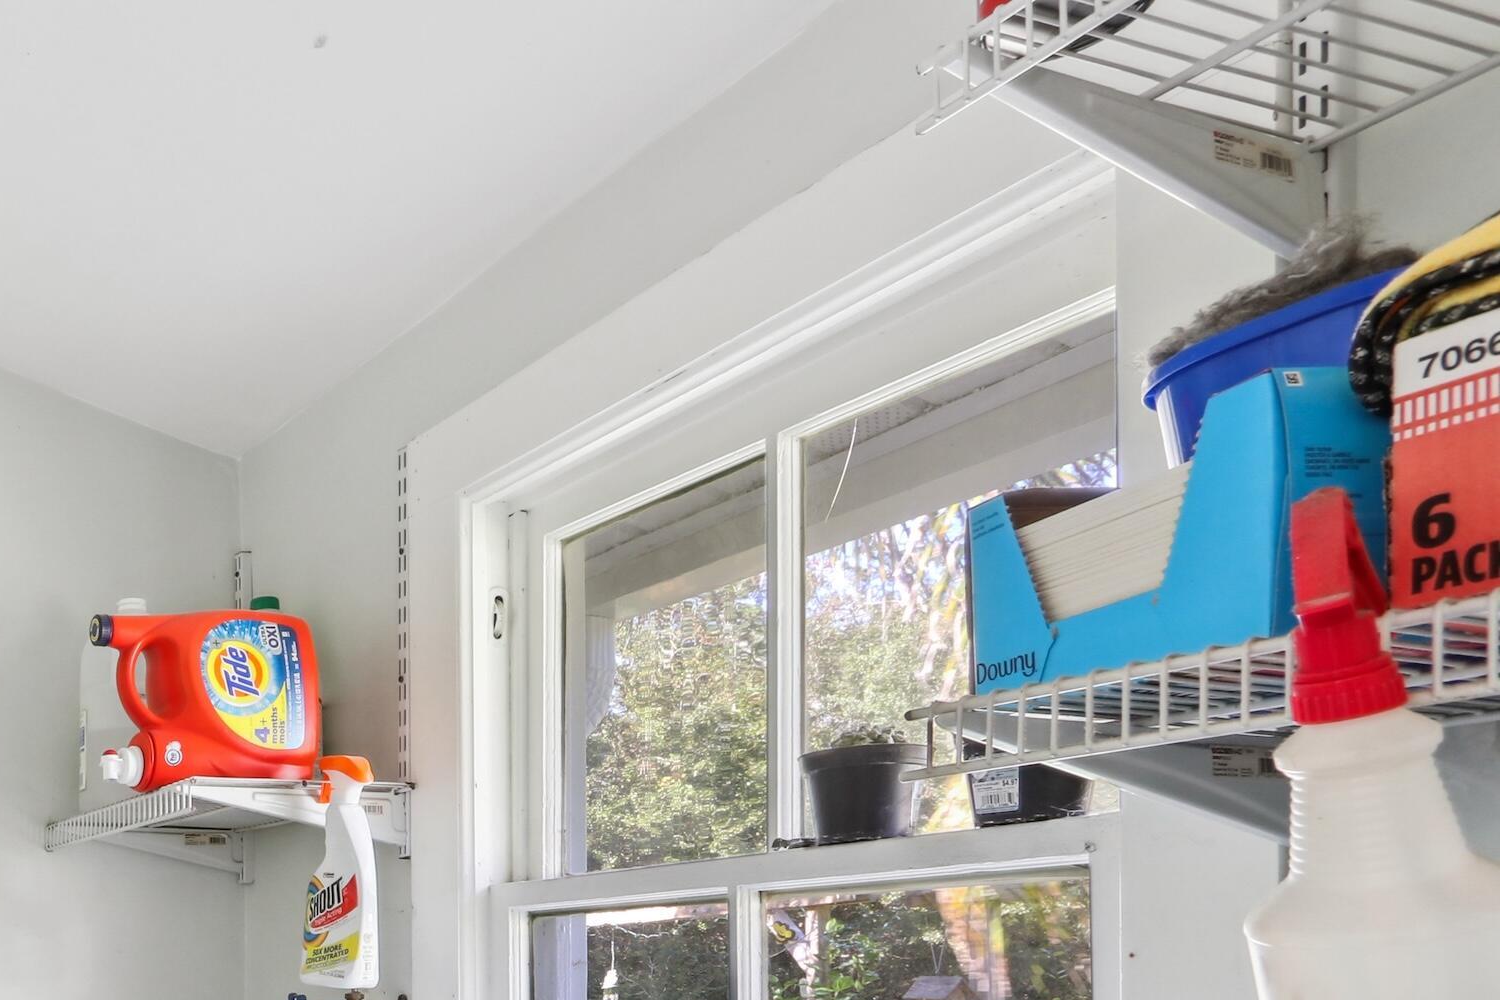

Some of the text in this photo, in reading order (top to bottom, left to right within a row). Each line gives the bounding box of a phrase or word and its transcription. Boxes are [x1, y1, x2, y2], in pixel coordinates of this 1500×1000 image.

[1412, 492, 1456, 549] 6
[266, 625, 280, 648] OXI
[221, 646, 261, 698] Tide
[975, 649, 1037, 685] Downy
[309, 876, 342, 922] SHOUT
